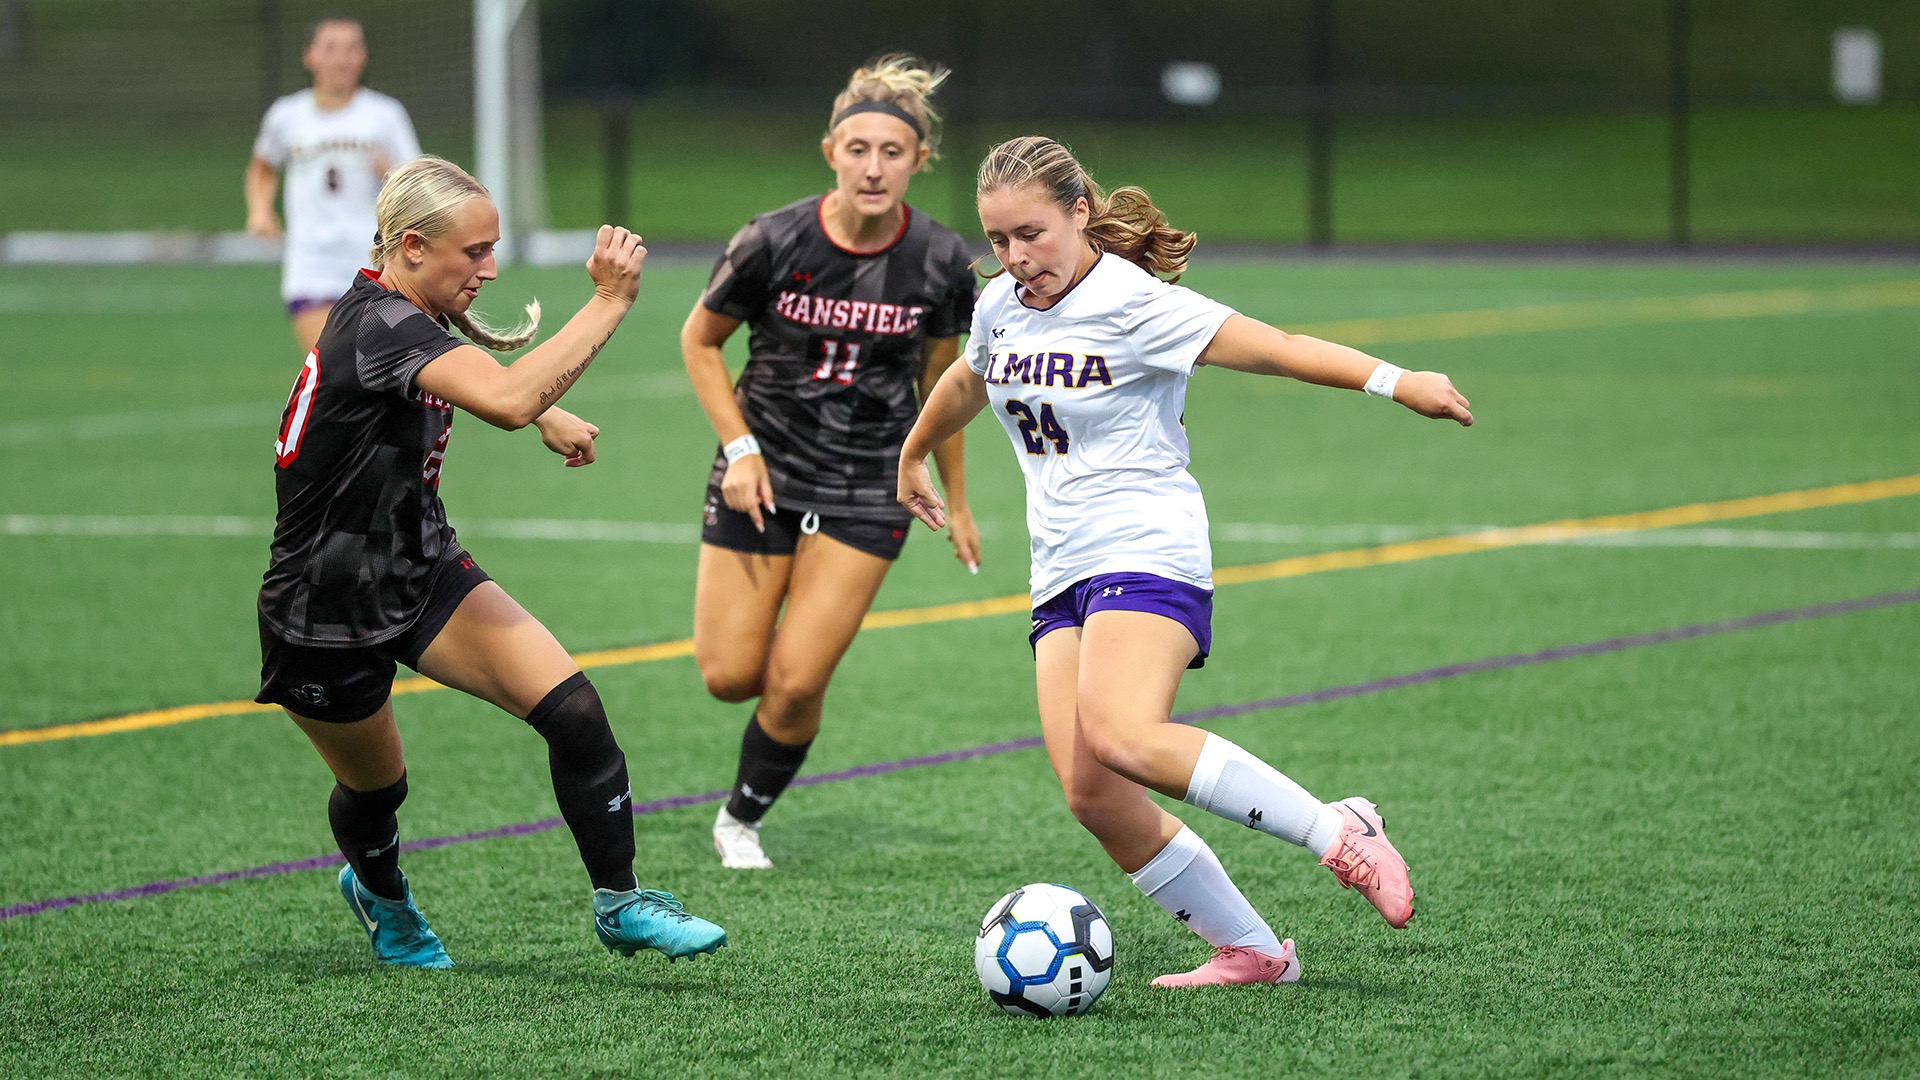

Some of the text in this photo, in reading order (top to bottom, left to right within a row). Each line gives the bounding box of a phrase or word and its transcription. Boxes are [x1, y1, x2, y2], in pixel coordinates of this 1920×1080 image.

[776, 290, 924, 334] MANSFIELD
[811, 339, 861, 386] 11
[984, 351, 1114, 388] LMIRA
[539, 385, 556, 405] And
[1004, 398, 1070, 456] 24
